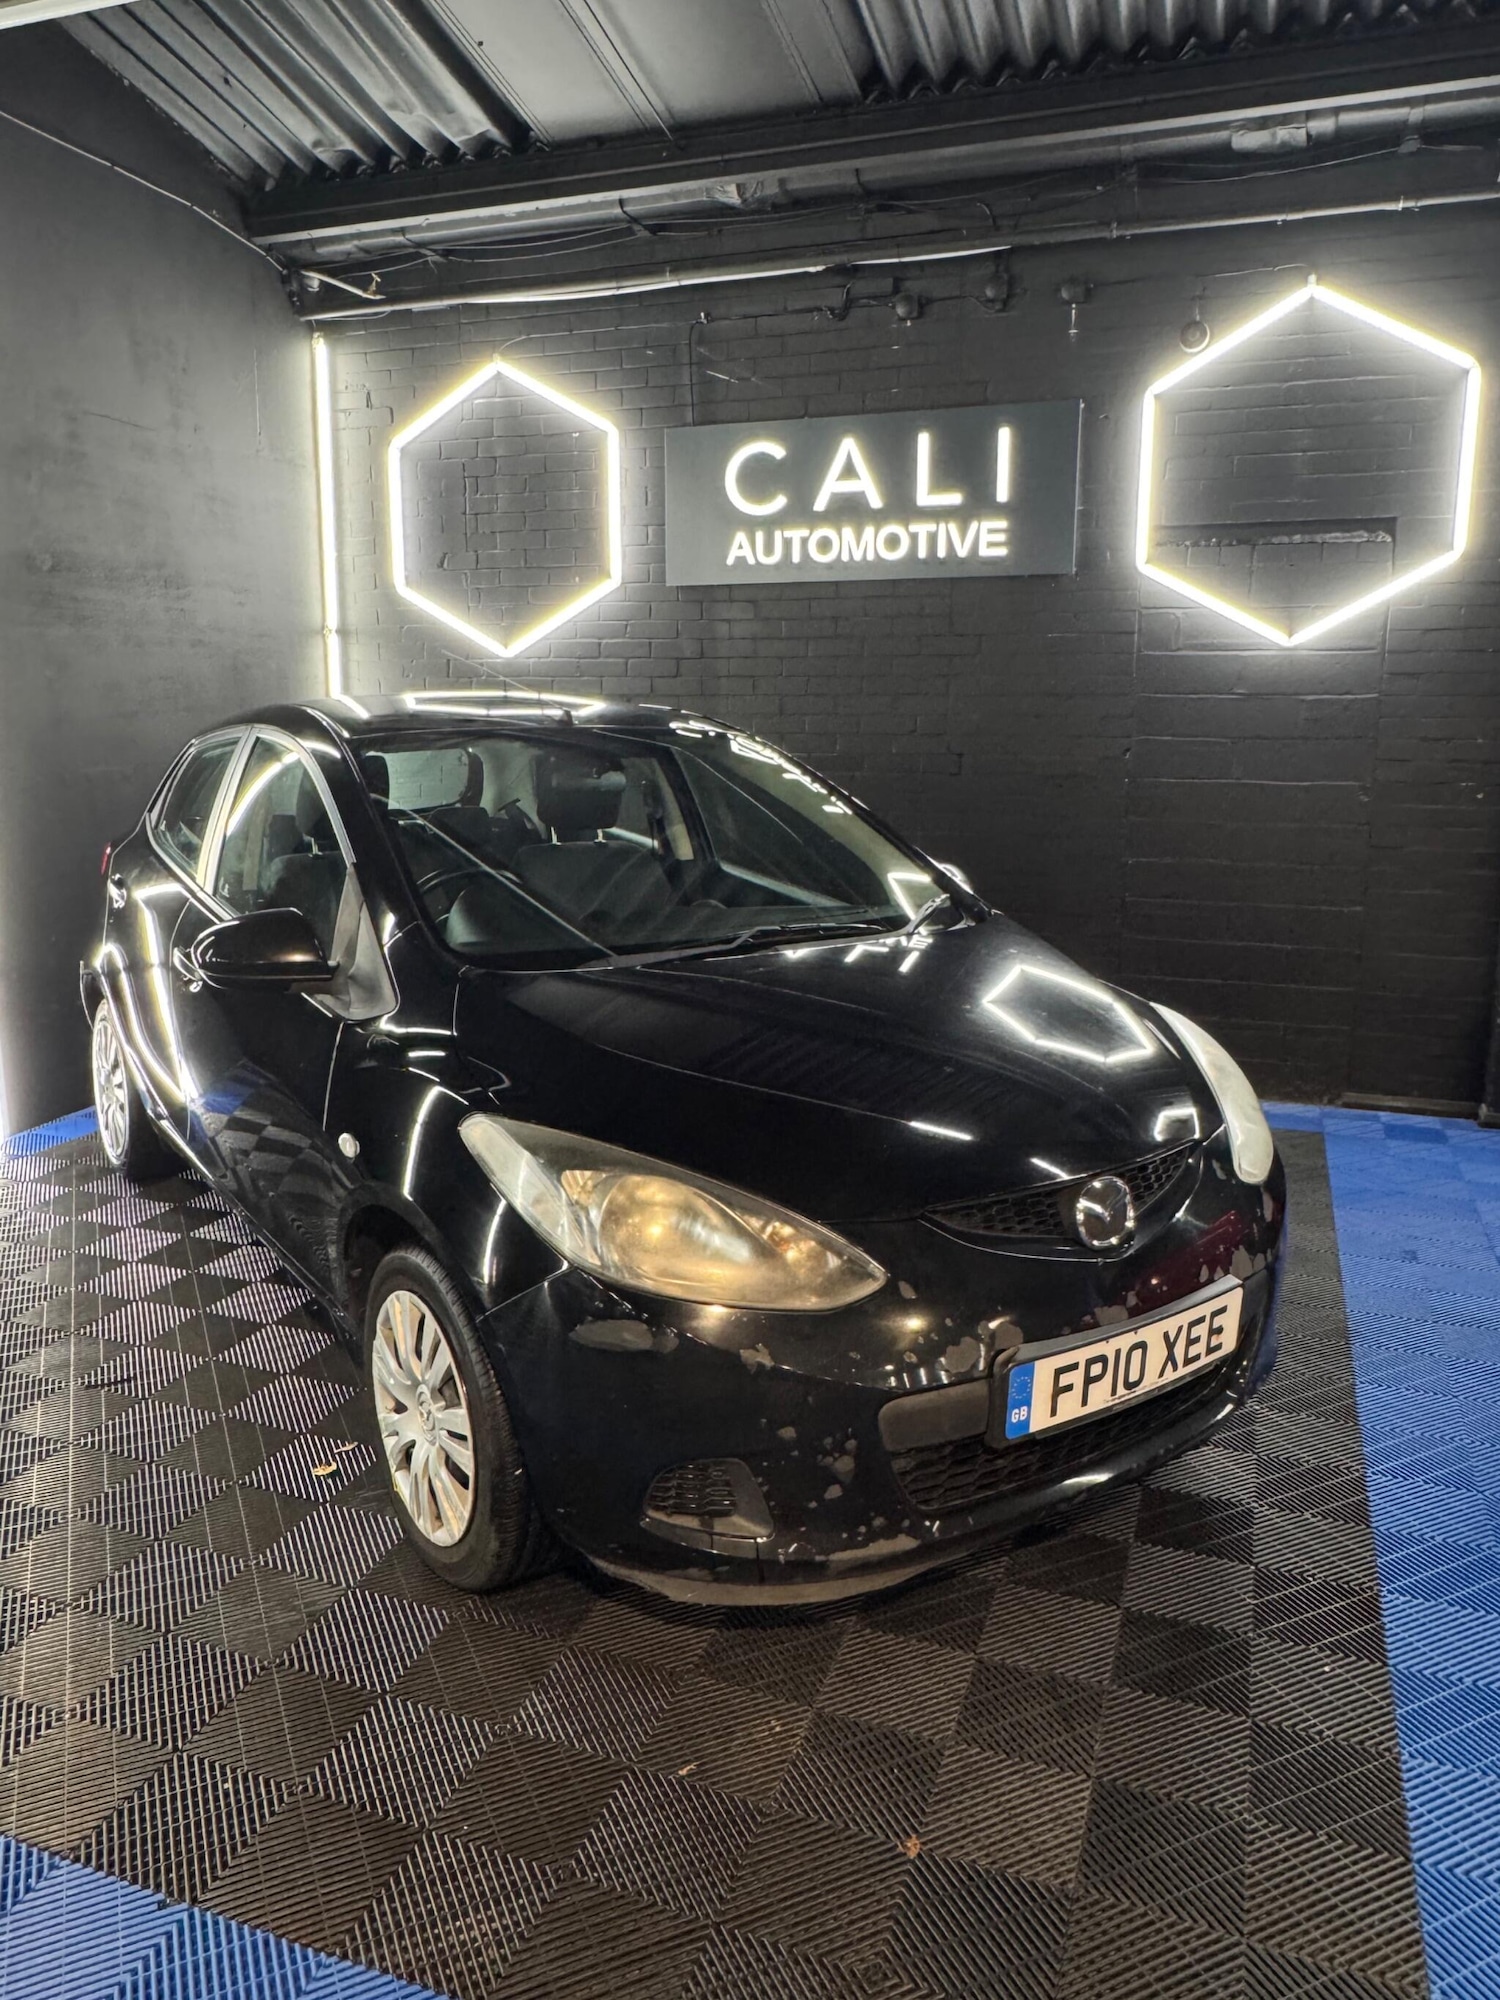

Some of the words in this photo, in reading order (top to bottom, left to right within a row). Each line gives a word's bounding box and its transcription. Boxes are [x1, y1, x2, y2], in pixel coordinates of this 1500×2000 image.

[725, 426, 1011, 516] CALI
[726, 520, 1009, 566] AUTOMOTIVE
[1049, 1339, 1148, 1418] FP10
[1157, 1304, 1229, 1379] XEE
[1010, 1405, 1028, 1424] GB
